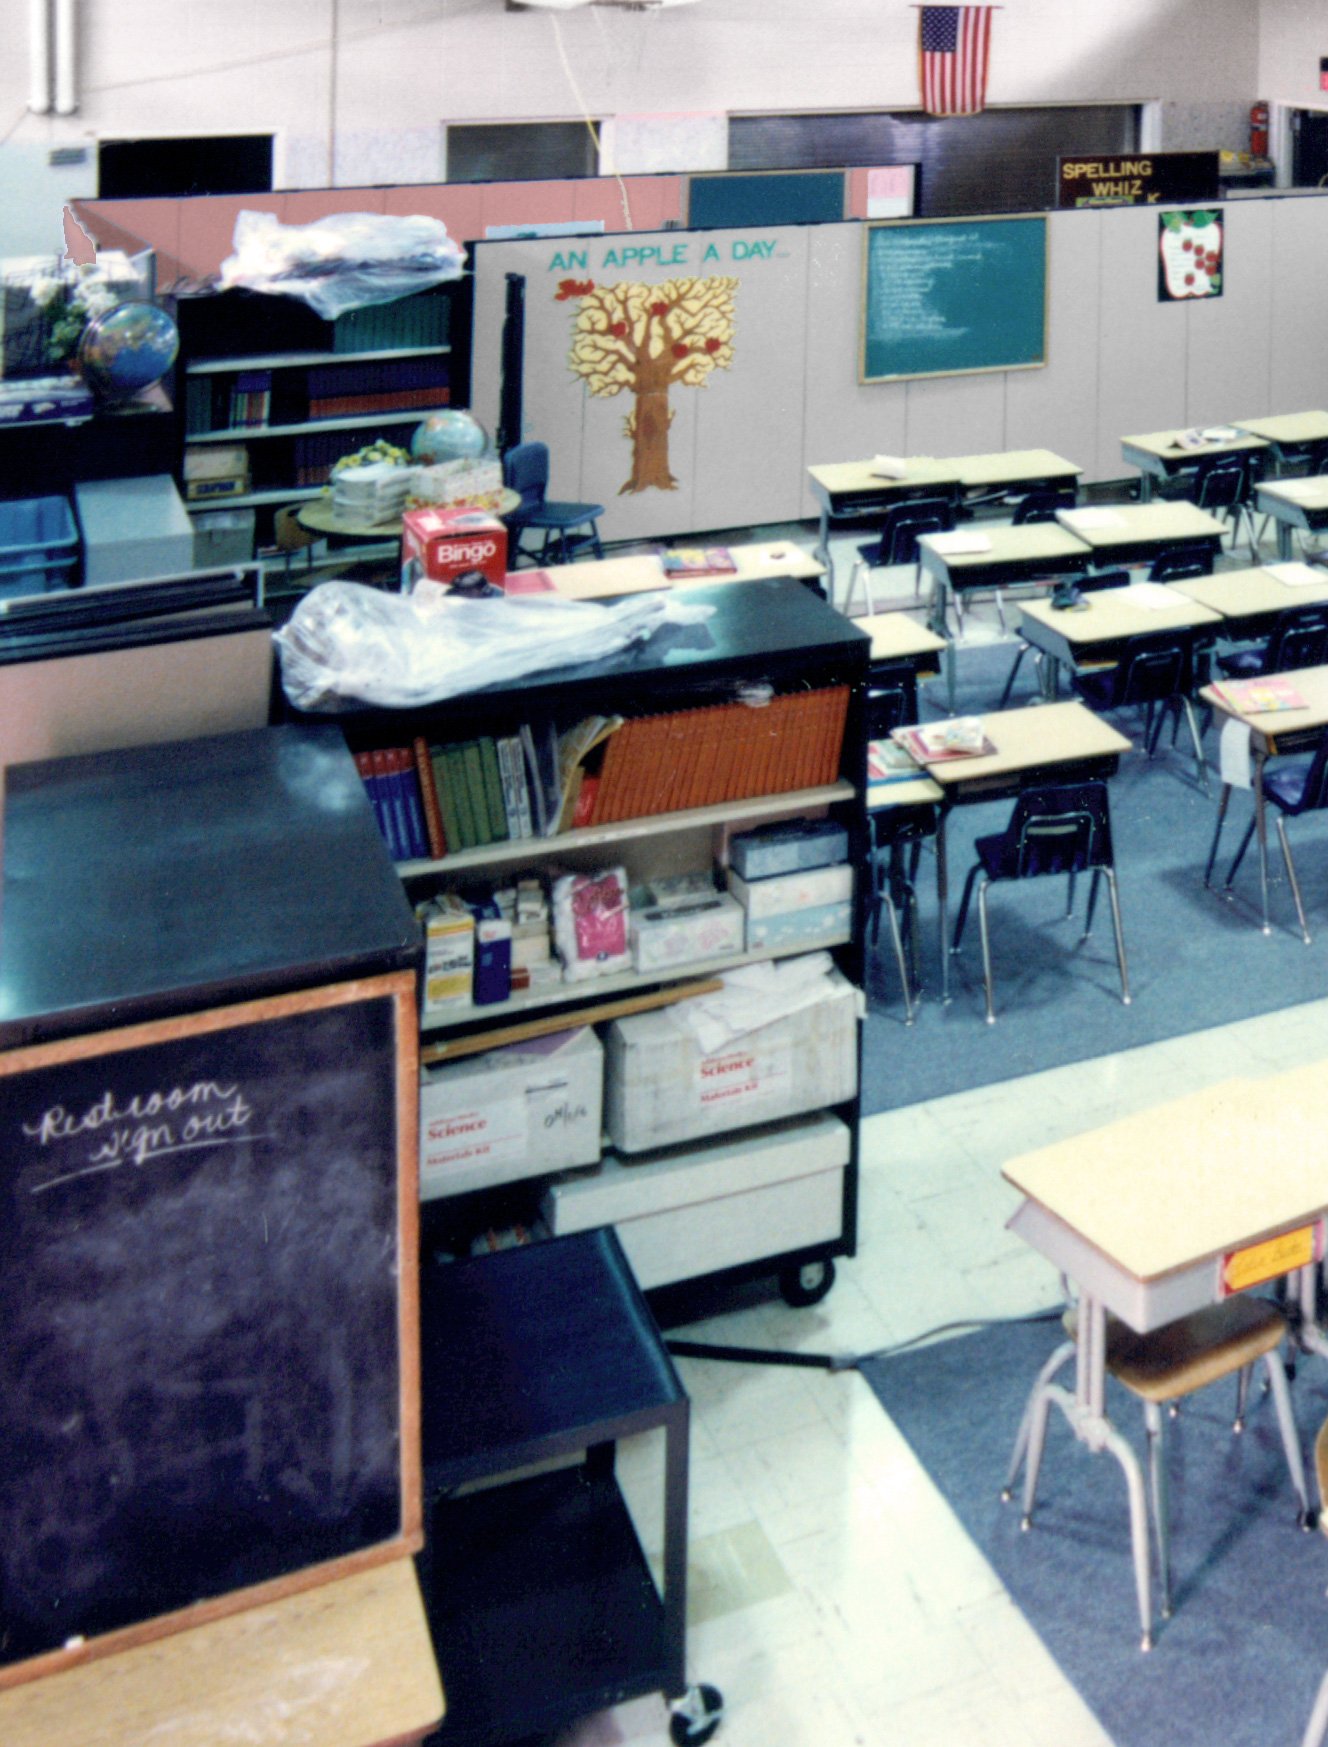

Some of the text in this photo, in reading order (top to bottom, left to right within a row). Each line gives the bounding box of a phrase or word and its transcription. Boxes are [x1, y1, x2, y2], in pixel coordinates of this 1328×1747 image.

[1062, 160, 1153, 179] SPELLING
[1092, 179, 1143, 196] WHIZ
[549, 250, 588, 272] AN
[602, 243, 689, 268] APPLE
[703, 243, 720, 262] A
[437, 541, 497, 565] Bingo
[700, 1057, 755, 1079] Science
[182, 1094, 252, 1141] out
[427, 1118, 488, 1141] Science
